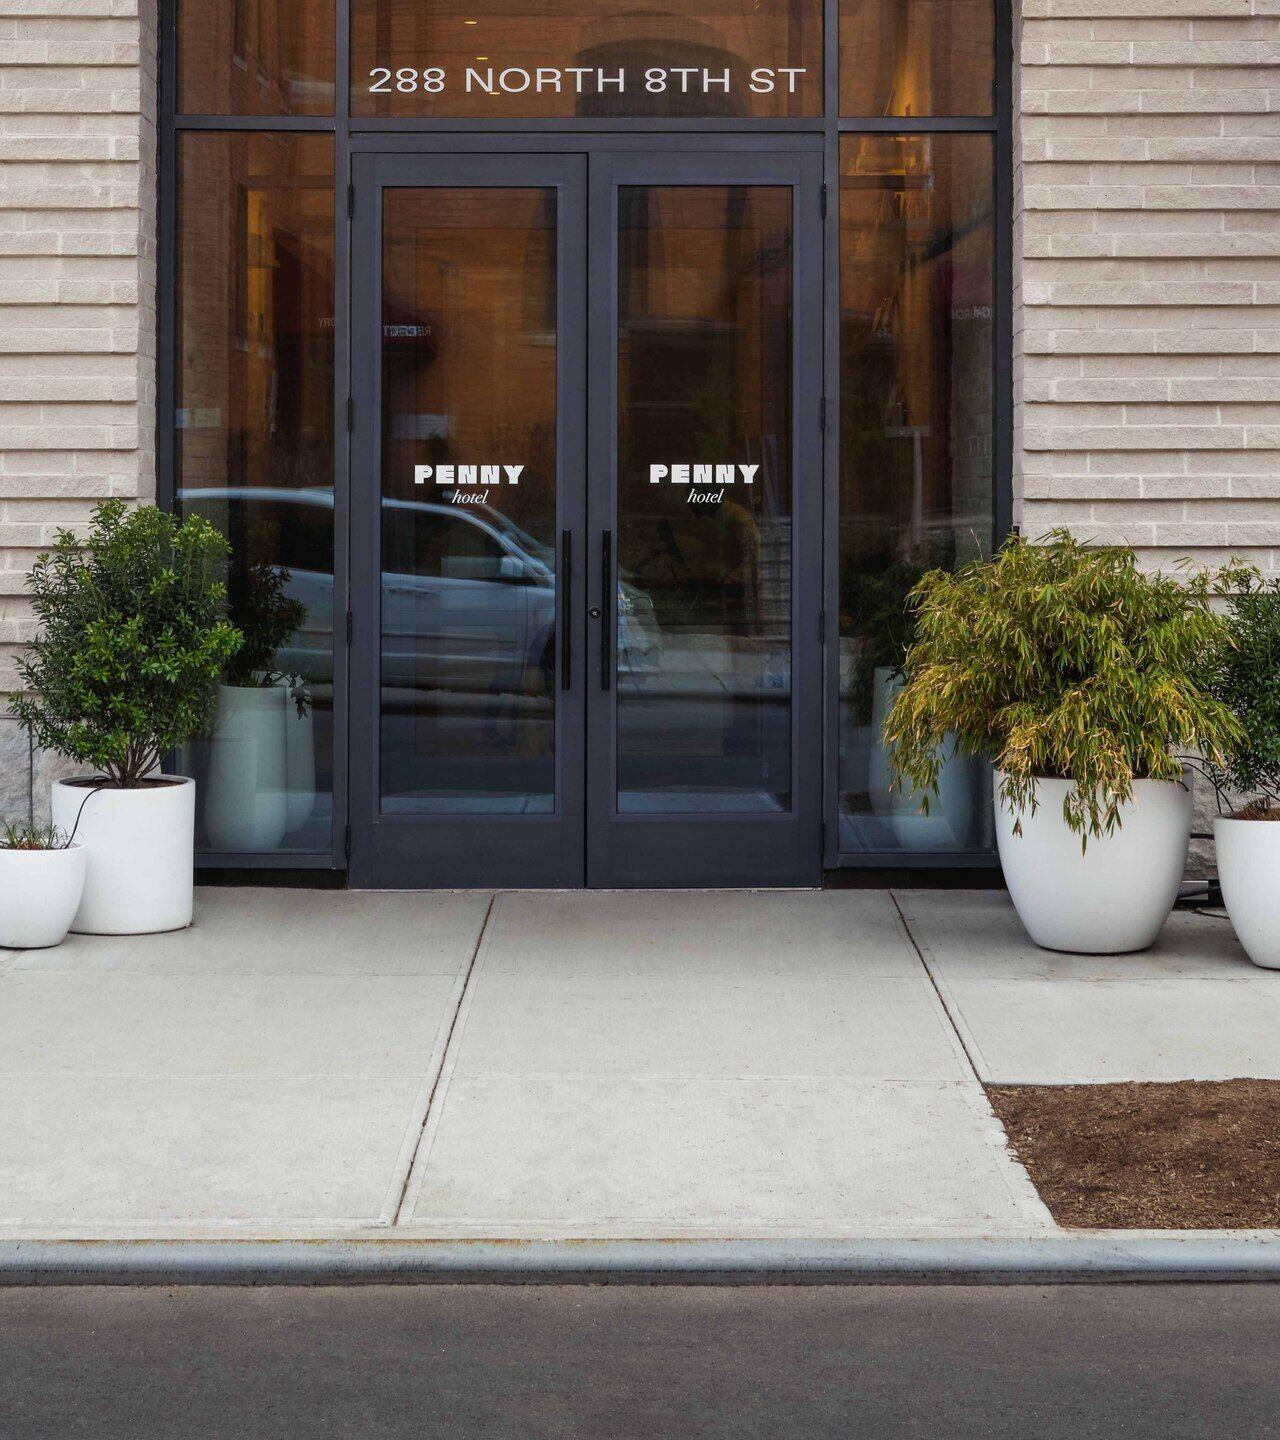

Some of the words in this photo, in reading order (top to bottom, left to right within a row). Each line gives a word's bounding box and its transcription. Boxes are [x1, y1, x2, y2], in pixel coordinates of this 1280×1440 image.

[368, 67, 446, 94] 288
[465, 67, 625, 94] NORTH
[644, 67, 730, 94] 8TH
[749, 67, 807, 94] ST
[414, 464, 525, 485] PENNY
[649, 464, 760, 484] PENNY
[451, 489, 489, 504] hotel
[686, 488, 725, 503] hotel
